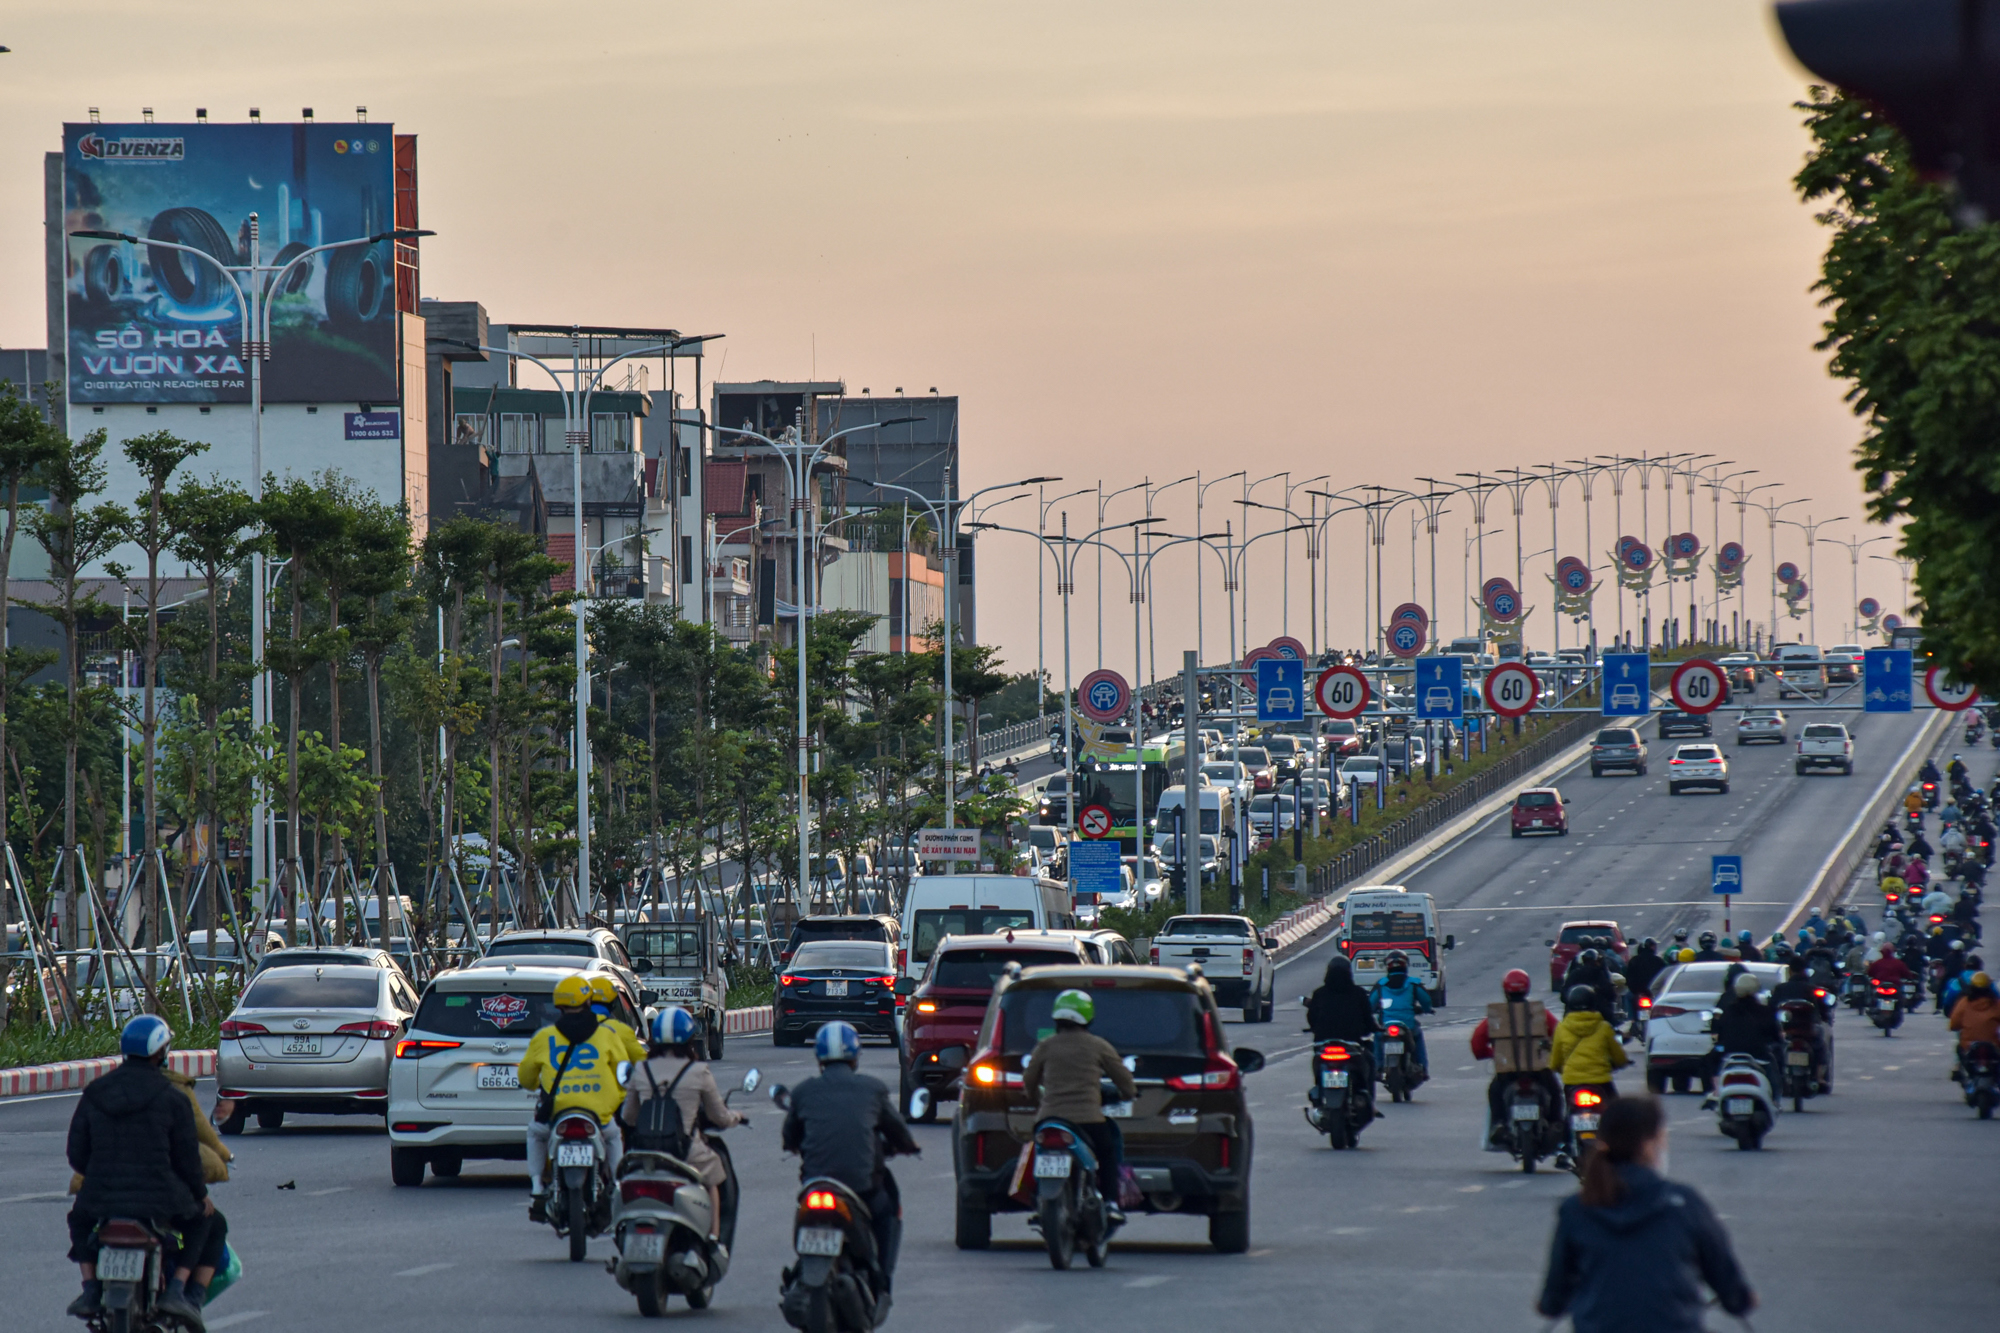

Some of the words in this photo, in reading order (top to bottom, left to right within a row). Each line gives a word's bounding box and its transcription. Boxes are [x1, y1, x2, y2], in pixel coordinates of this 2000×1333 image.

[82, 137, 184, 158] ADVENZA
[82, 352, 184, 375] VƯƠN
[194, 355, 245, 374] XA
[84, 381, 160, 389] DIGITIZATION
[163, 380, 219, 388] REACHES
[222, 380, 245, 388] FAR
[1332, 681, 1354, 703] 60
[1501, 678, 1524, 701] 60
[1688, 675, 1710, 698] 60
[286, 1044, 317, 1052] 452.10
[294, 1035, 310, 1044] 99A
[548, 1035, 599, 1073] be
[490, 1066, 510, 1076] 34A
[482, 1077, 518, 1087] 666.46
